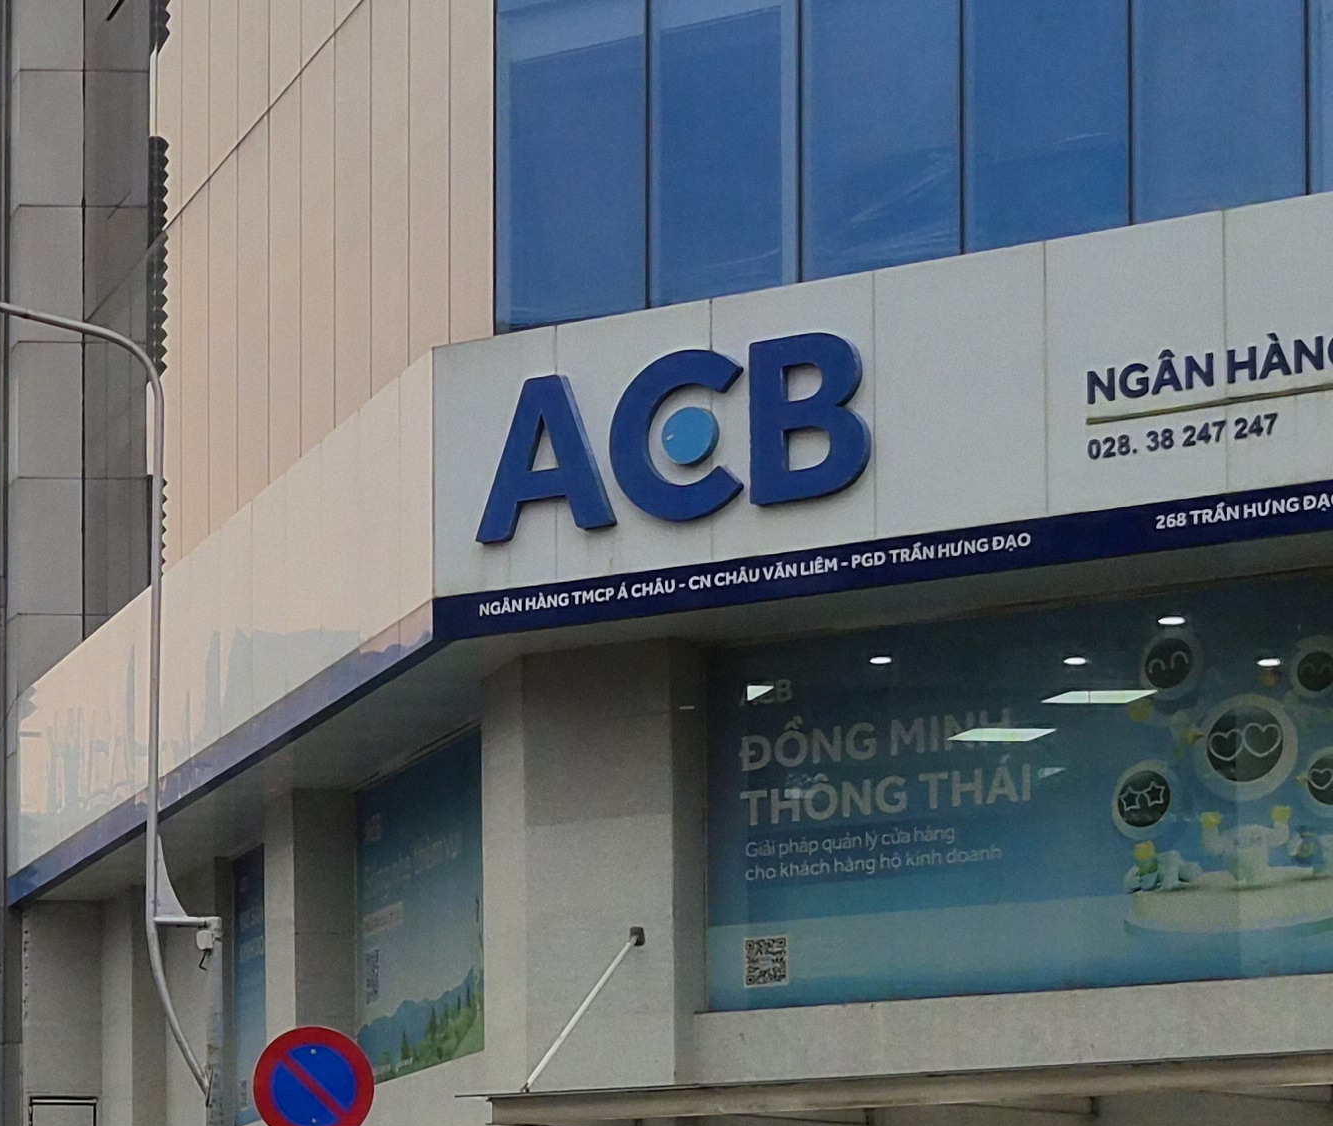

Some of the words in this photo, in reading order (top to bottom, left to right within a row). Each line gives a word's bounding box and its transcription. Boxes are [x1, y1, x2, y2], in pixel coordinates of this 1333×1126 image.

[1087, 349, 1214, 405] NGÂN
[1226, 332, 1333, 385] HÀN
[476, 331, 873, 546] ACB
[1087, 434, 1137, 460] 028.
[1146, 428, 1174, 451] 38
[1182, 419, 1226, 447] 247
[1234, 412, 1278, 440] 247
[1156, 513, 1187, 529] 268
[1189, 502, 1239, 526] TRẦN
[1243, 498, 1299, 518] HƯNG
[1303, 493, 1333, 511] ĐẠ
[479, 596, 522, 617] NGÂN
[525, 592, 569, 611] HÀNG
[572, 588, 614, 605] TMCP
[617, 582, 628, 600] Á
[632, 577, 676, 598] CHÂU
[688, 574, 711, 591] CN
[714, 565, 760, 586] CHÂU
[763, 561, 797, 581] VĂN
[800, 556, 838, 576] LIÊM
[851, 552, 886, 569] PGD
[889, 541, 935, 564] TRẦN
[937, 537, 989, 558] HƯNG
[991, 532, 1032, 552] ĐẠO
[738, 715, 878, 772] ĐỒNG
[890, 708, 1012, 756] MINH
[740, 772, 908, 826] THÔNG
[918, 753, 1032, 809] THÁI
[744, 864, 776, 881] cho
[779, 856, 830, 877] khách
[834, 853, 876, 876] hàng
[905, 848, 943, 867] kinh
[945, 843, 1003, 864] doanh
[778, 834, 819, 864] pháp
[913, 825, 956, 849] hàng
